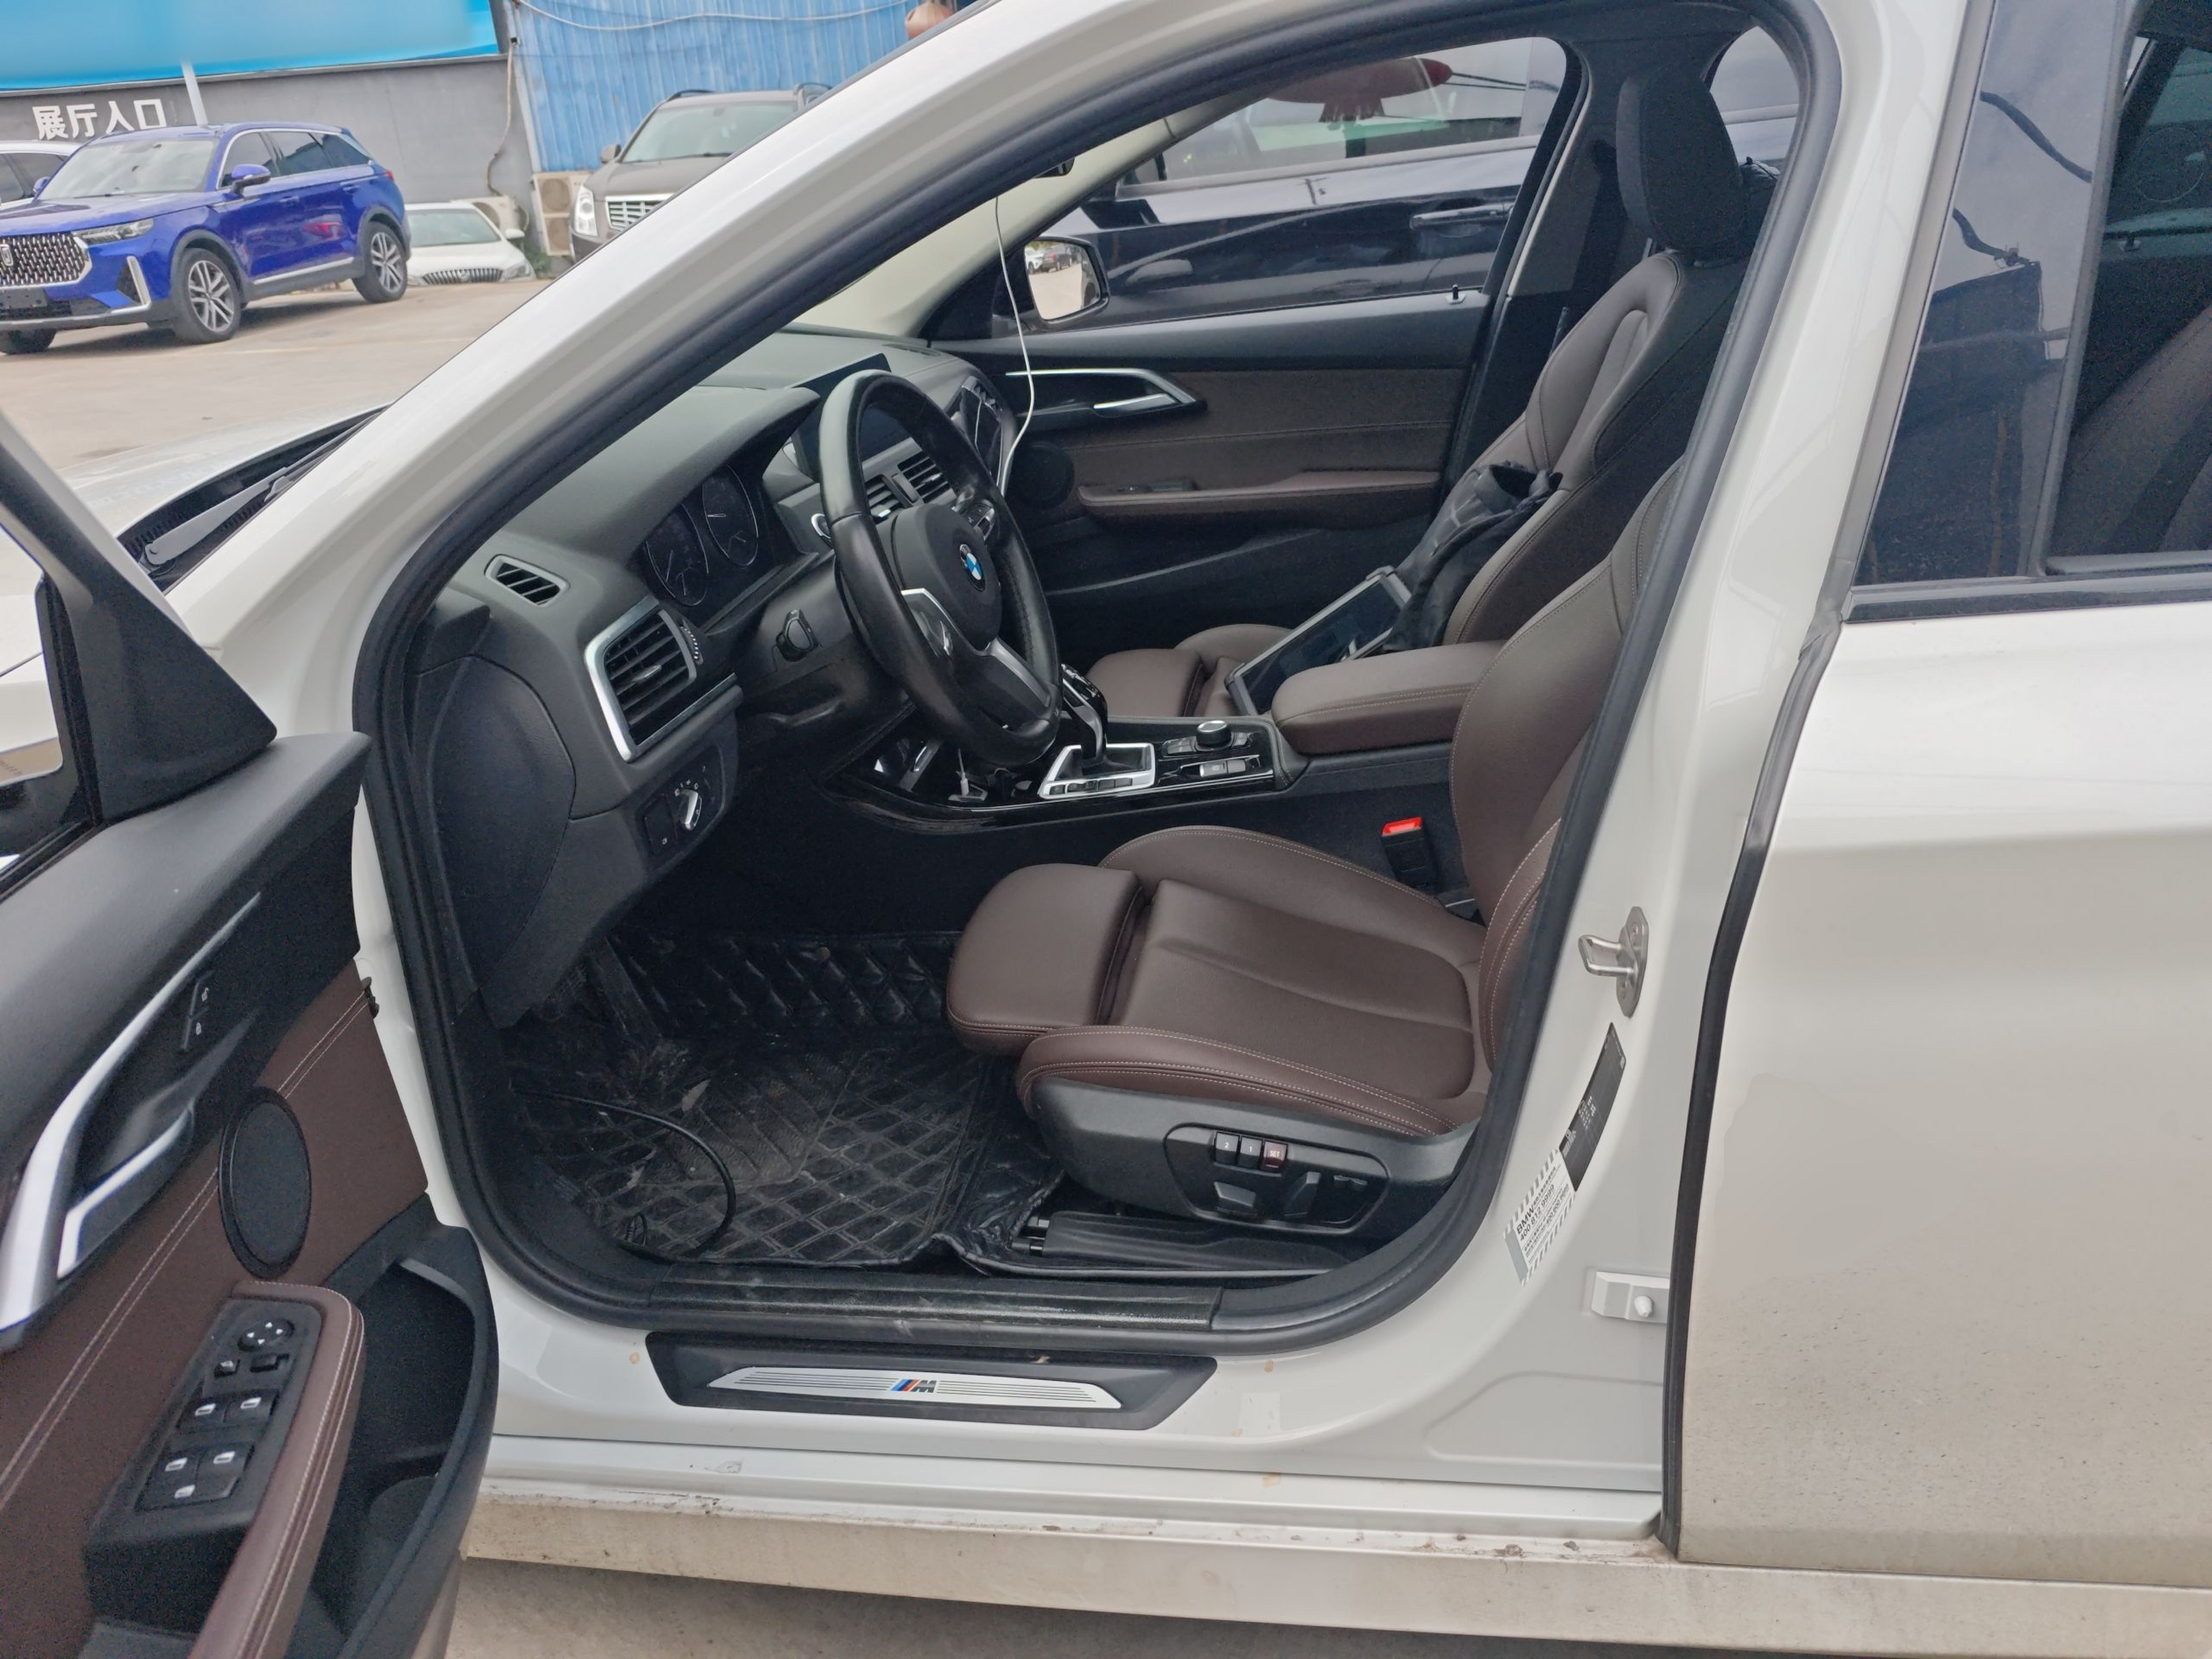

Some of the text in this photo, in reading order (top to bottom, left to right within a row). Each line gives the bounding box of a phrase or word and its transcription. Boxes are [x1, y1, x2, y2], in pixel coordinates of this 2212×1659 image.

[32, 99, 166, 140] 展厅入口
[1517, 1204, 1534, 1234] BMW
[1520, 1224, 1531, 1241] 400
[1531, 1206, 1541, 1225] 812
[1541, 1184, 1554, 1207] 9999
[910, 1380, 937, 1393] M
